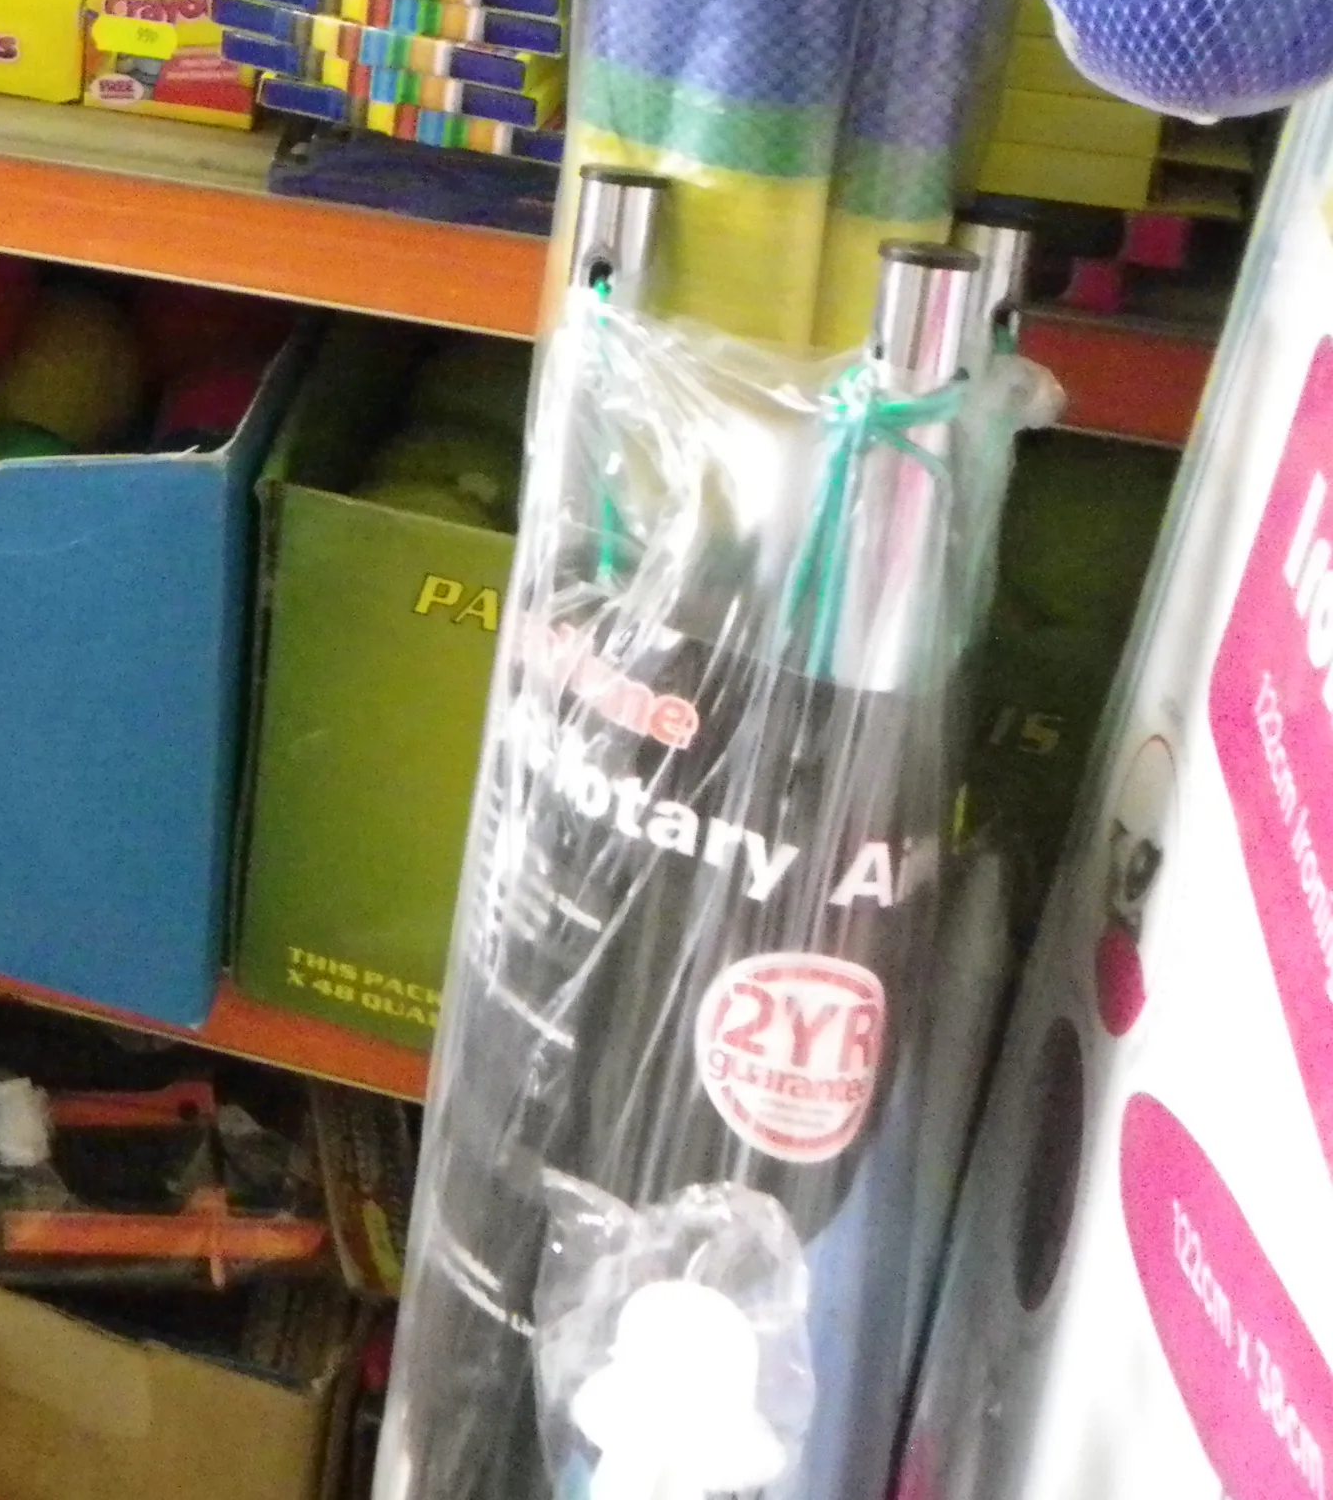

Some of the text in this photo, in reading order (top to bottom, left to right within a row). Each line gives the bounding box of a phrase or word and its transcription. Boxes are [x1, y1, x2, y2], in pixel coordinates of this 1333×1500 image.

[413, 572, 501, 632] PA
[528, 725, 800, 903] otary
[287, 967, 306, 988] X
[288, 945, 358, 981] THIS
[720, 982, 882, 1078] 2YR
